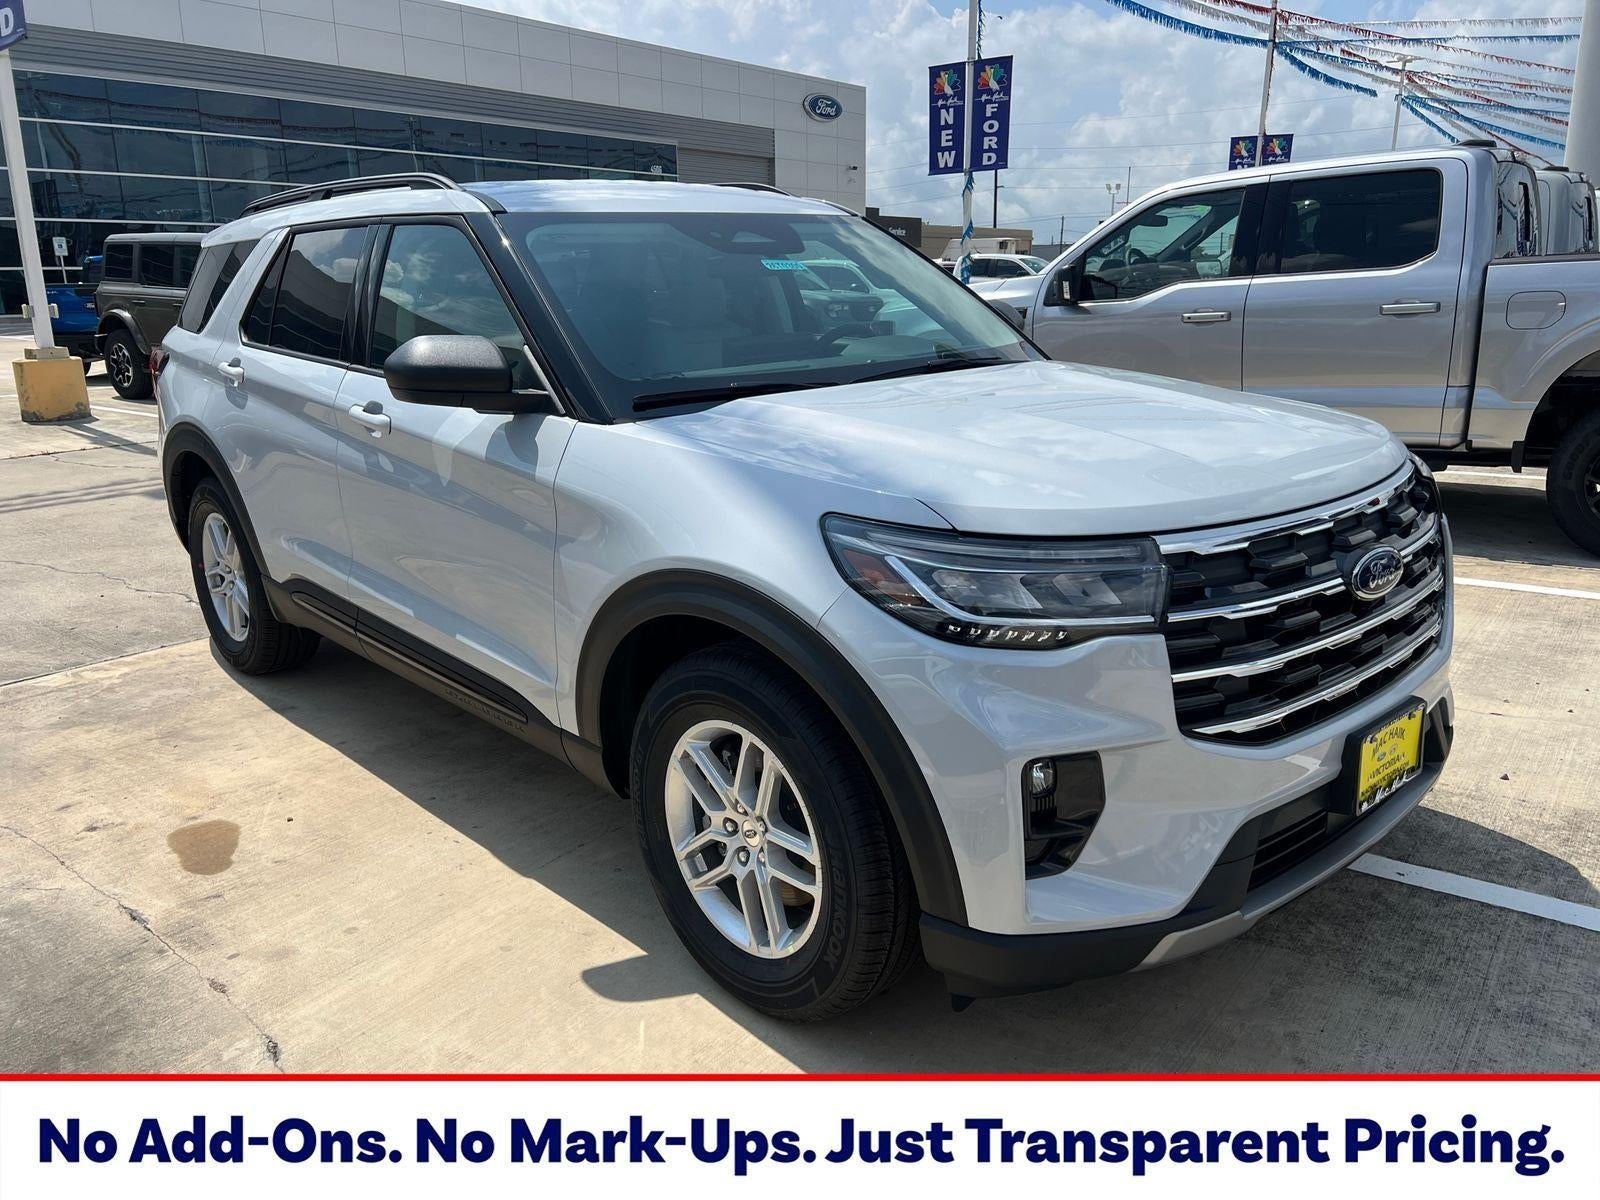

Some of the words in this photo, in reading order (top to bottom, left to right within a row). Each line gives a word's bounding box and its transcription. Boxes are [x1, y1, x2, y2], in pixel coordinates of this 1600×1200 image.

[815, 98, 837, 116] Ford
[937, 107, 956, 168] NEW
[982, 103, 1000, 166] FORD
[1369, 557, 1396, 588] Ford
[1389, 727, 1406, 741] HAIK
